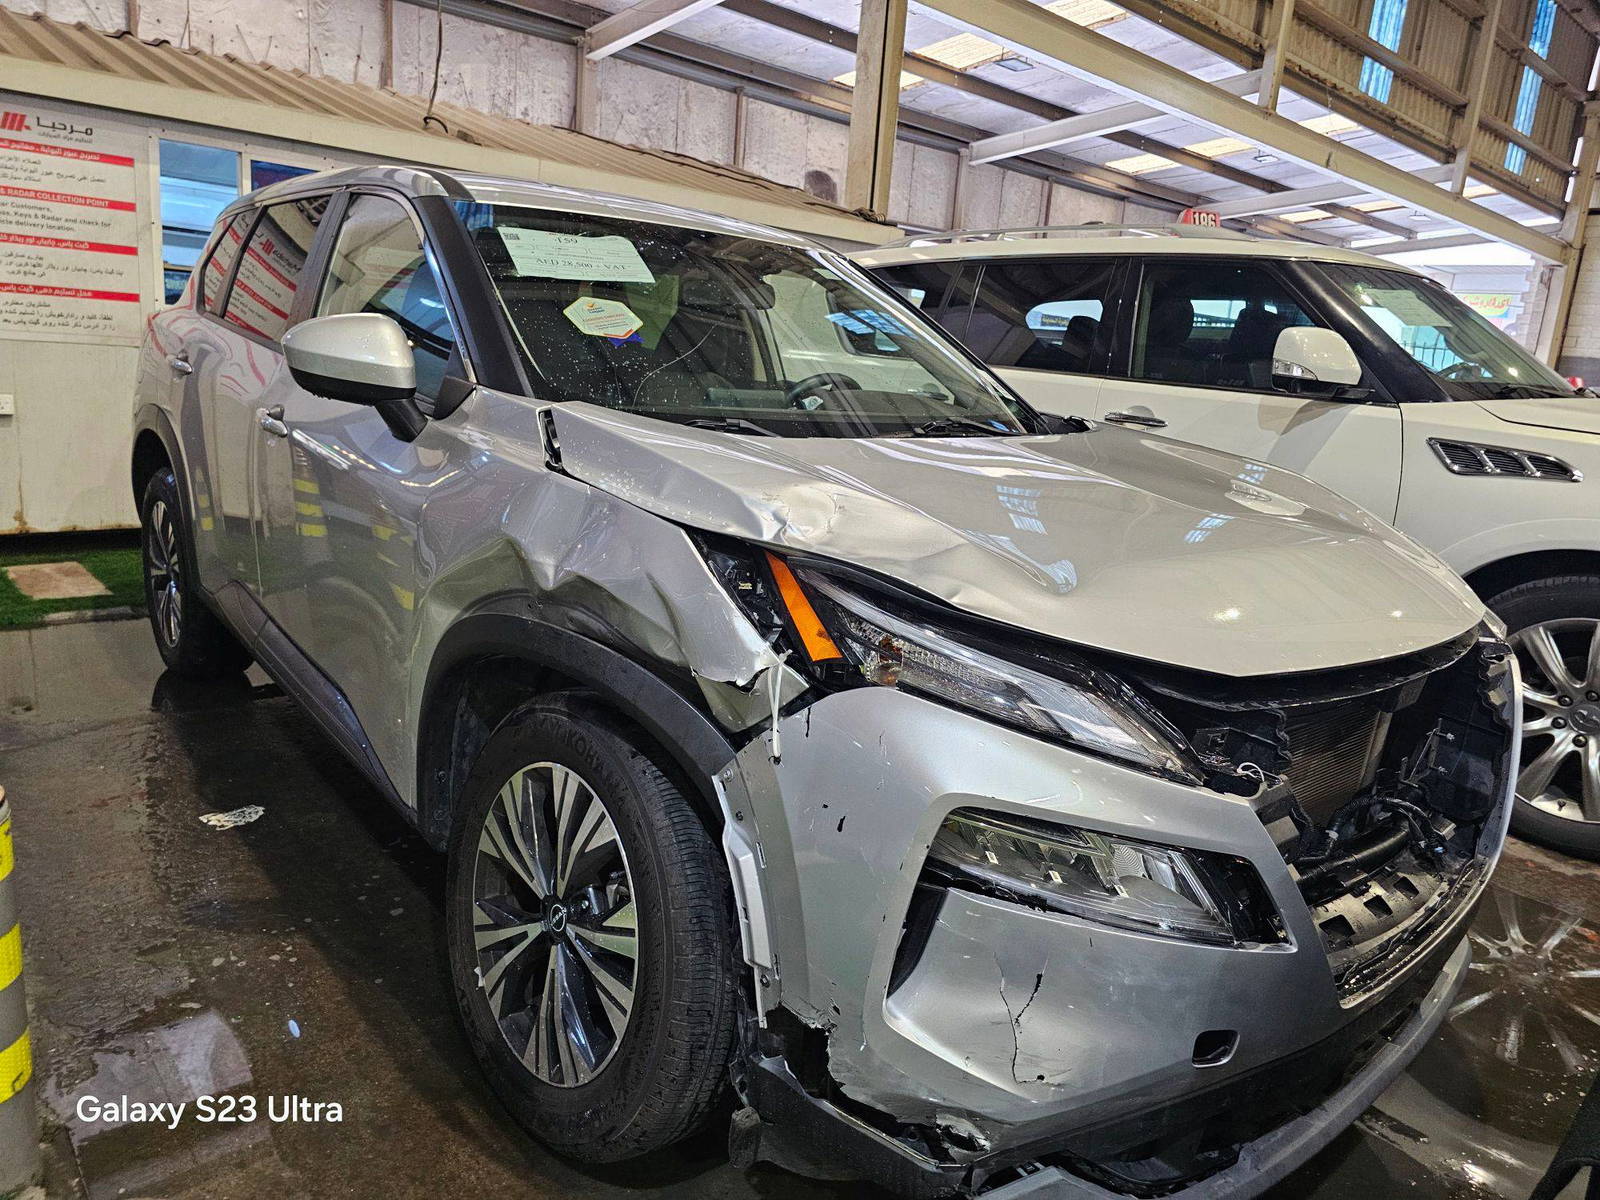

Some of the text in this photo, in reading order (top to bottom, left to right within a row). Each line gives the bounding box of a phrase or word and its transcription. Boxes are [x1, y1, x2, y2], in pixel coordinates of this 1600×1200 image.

[36, 116, 93, 136] مرحبا
[7, 188, 35, 198] RADAR
[36, 191, 85, 205] COLLECTION
[86, 198, 110, 207] POINT
